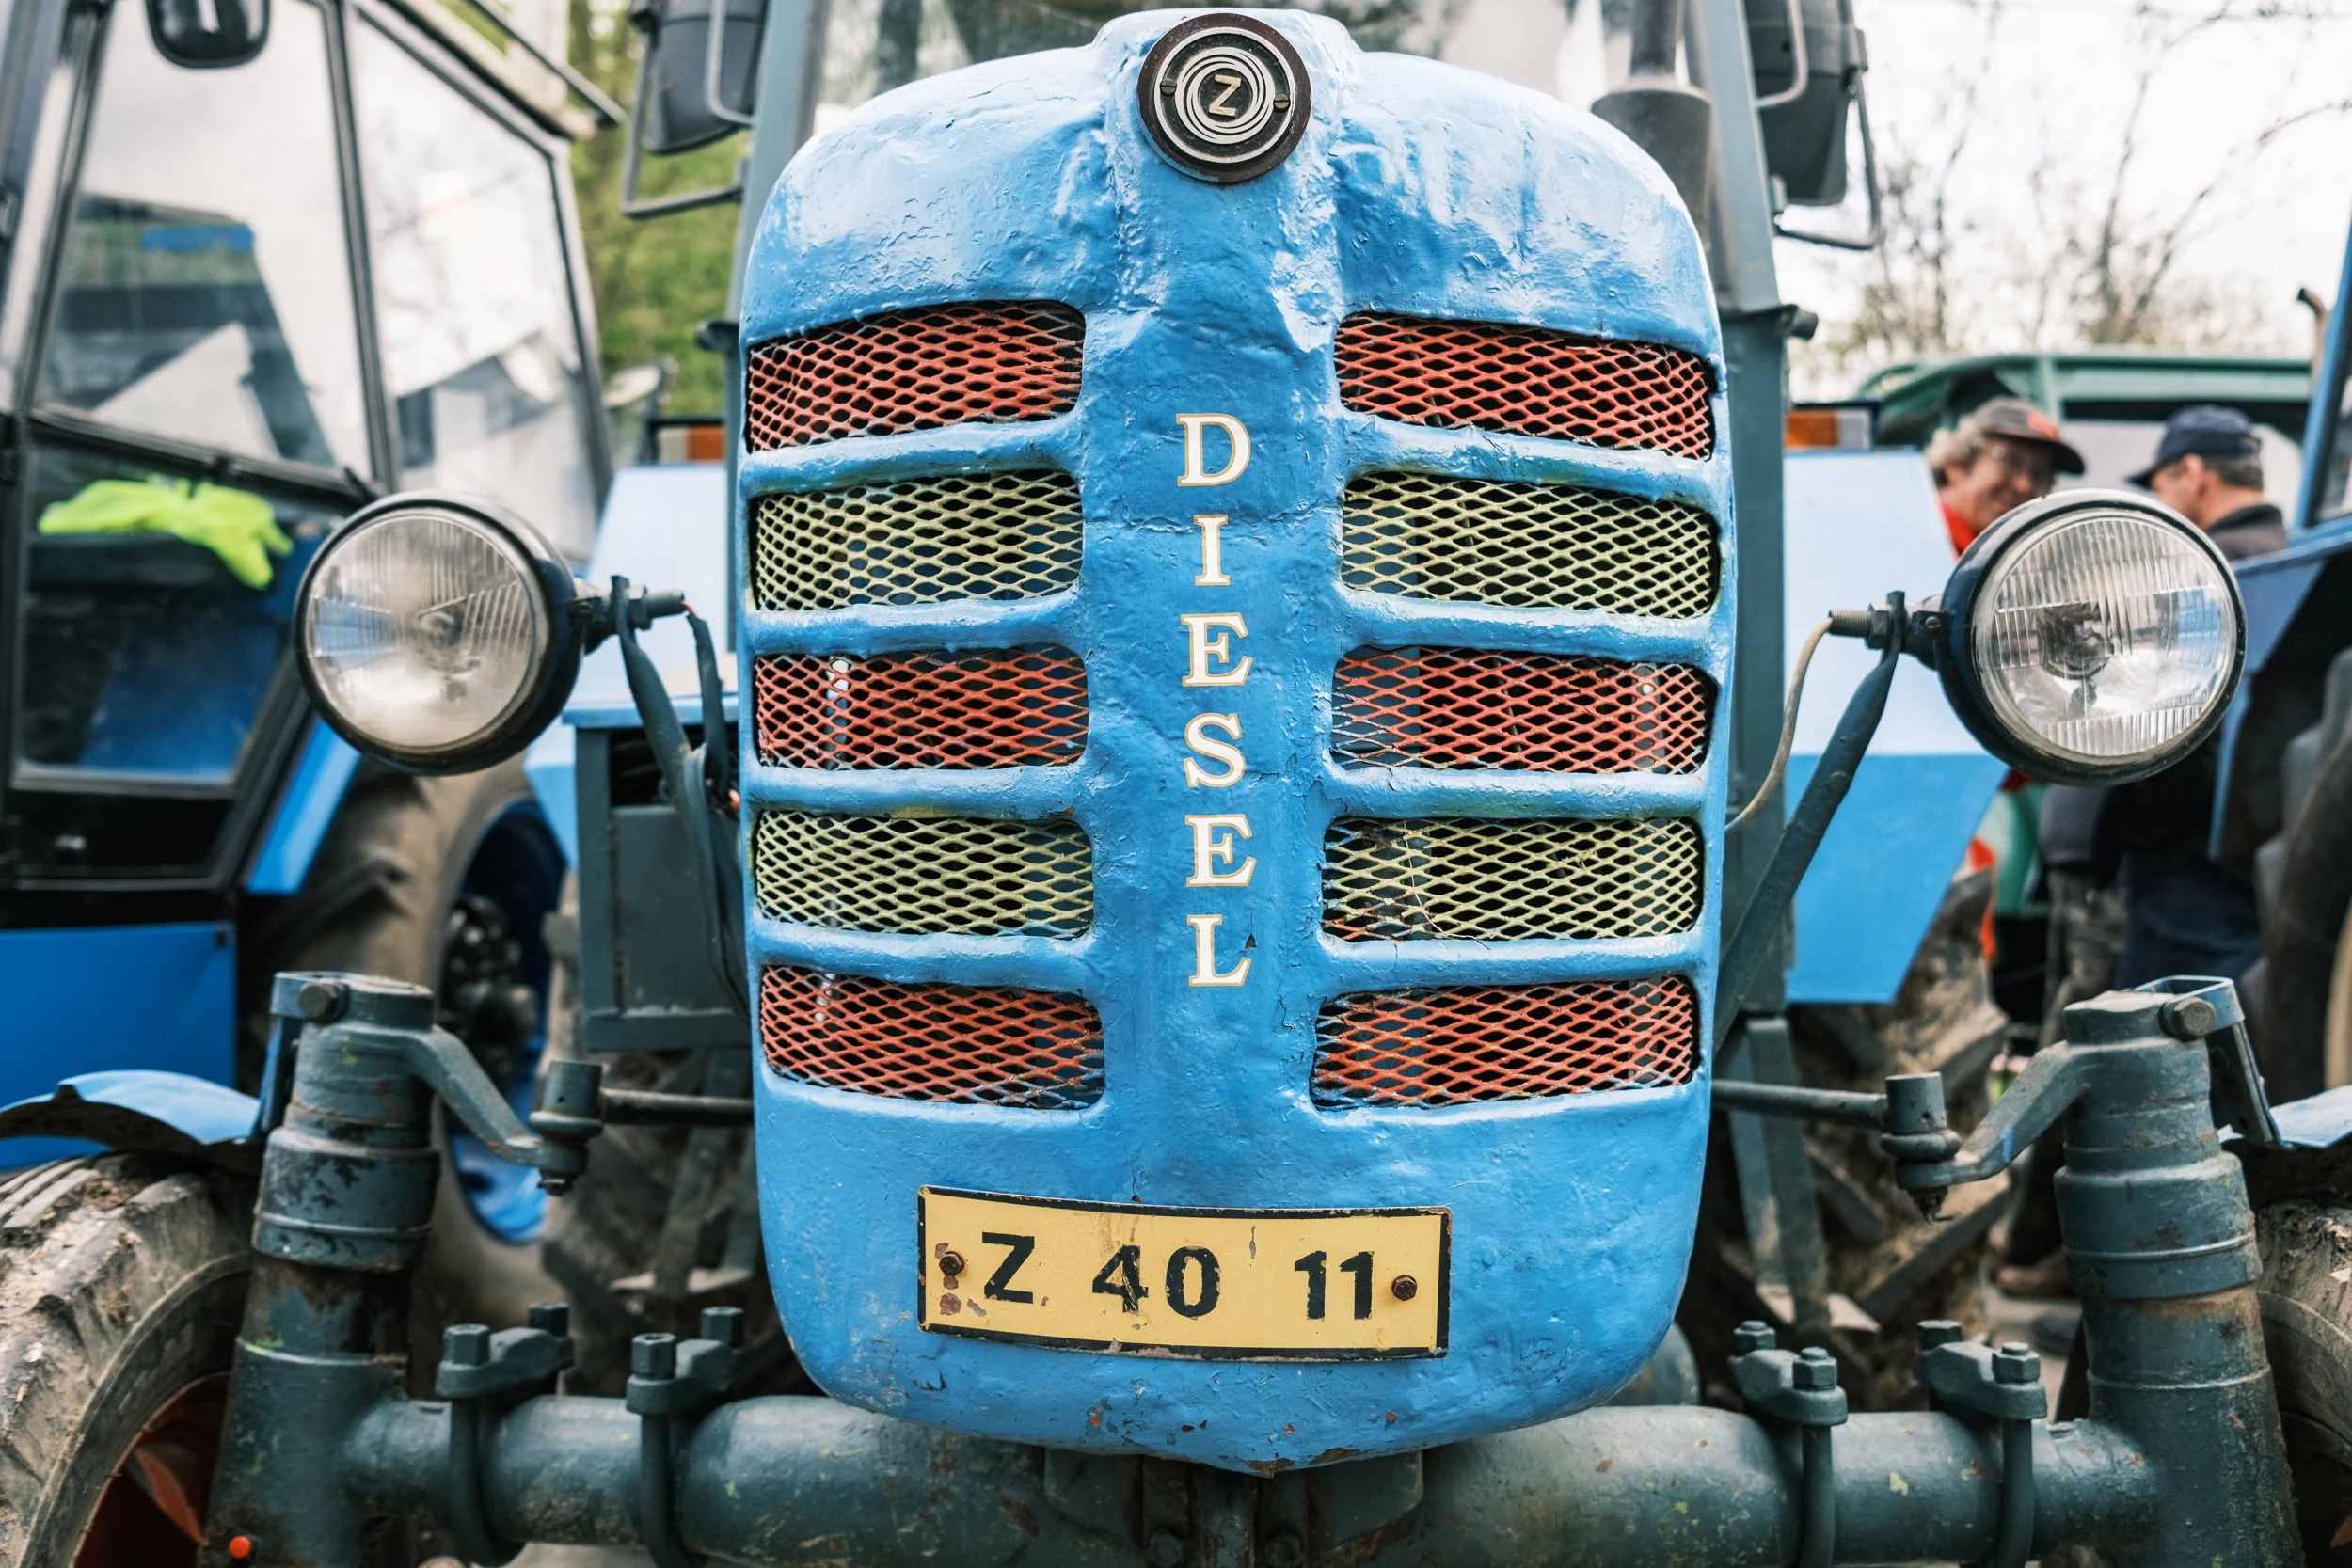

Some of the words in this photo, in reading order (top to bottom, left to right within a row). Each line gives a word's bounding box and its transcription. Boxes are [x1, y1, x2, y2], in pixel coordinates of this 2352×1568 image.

[1208, 74, 1242, 118] Z
[1176, 413, 1256, 987] DIESEL
[981, 1231, 1036, 1304] Z
[1092, 1244, 1221, 1318] 40
[1295, 1251, 1374, 1320] 11
